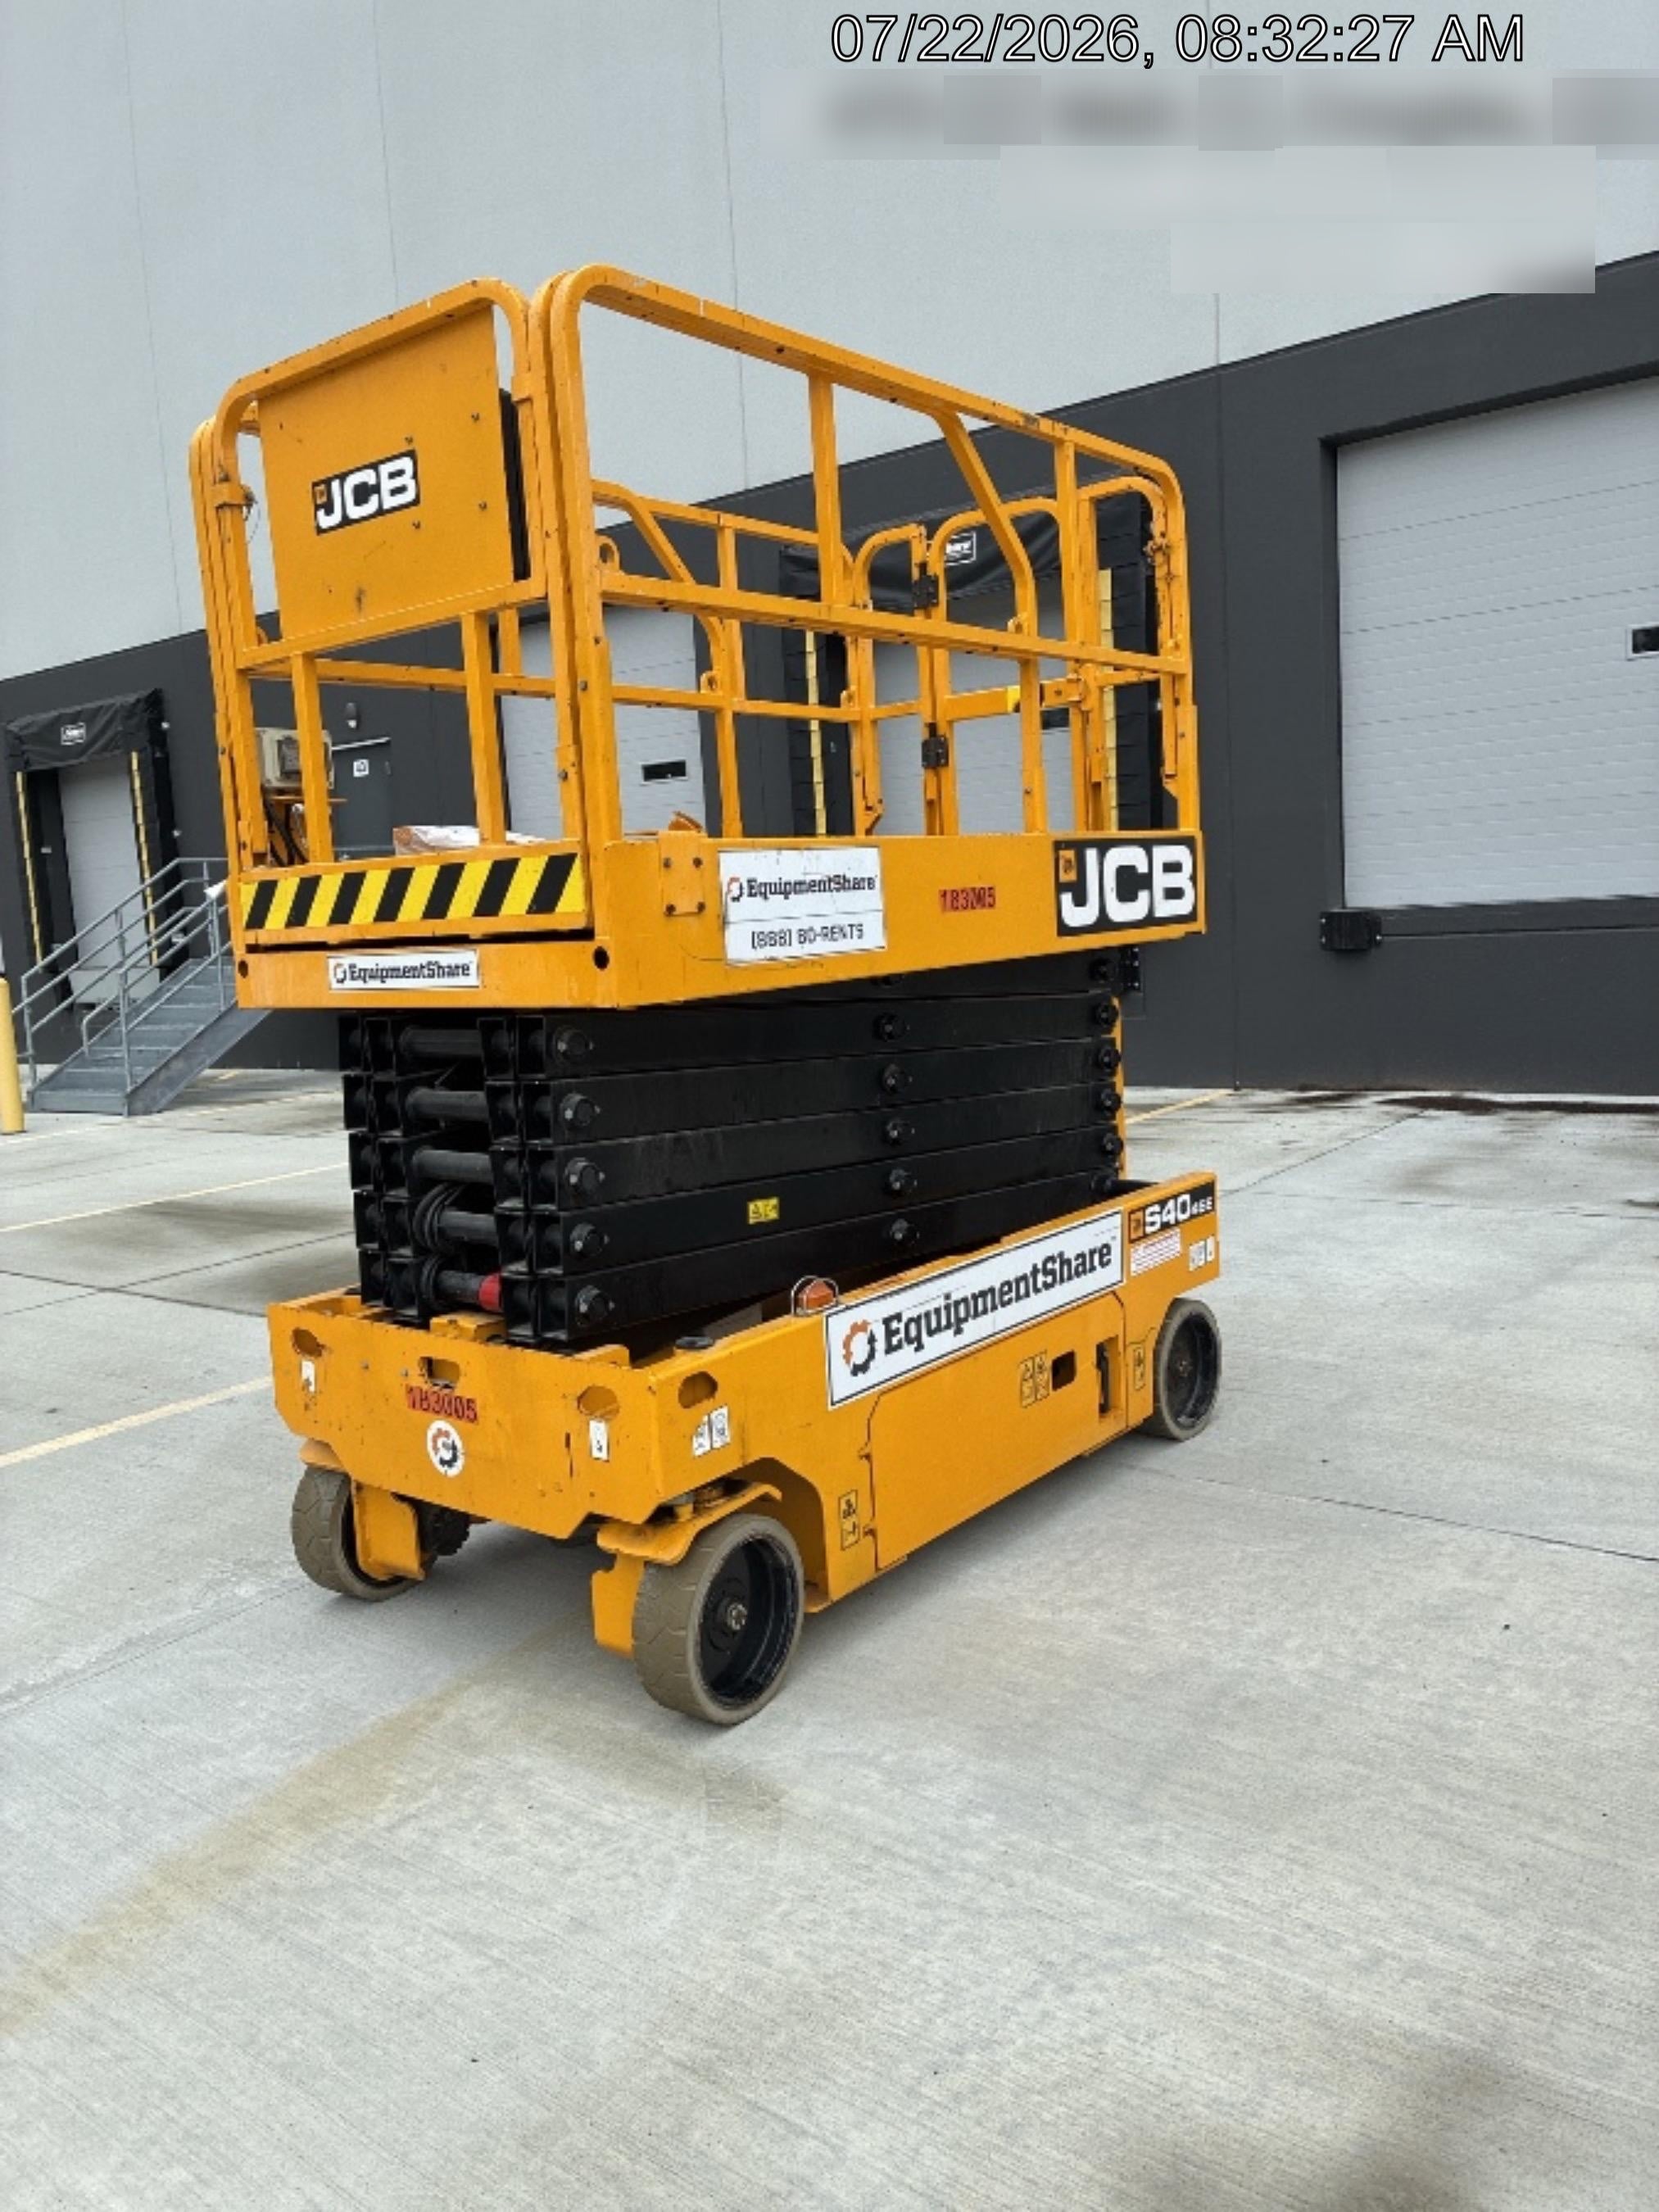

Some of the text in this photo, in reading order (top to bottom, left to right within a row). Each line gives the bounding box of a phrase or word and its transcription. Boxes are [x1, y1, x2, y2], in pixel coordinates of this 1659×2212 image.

[315, 456, 417, 530] JCB
[746, 873, 876, 900] EquipmentShare
[1060, 844, 1195, 927] JCB
[348, 959, 470, 984] EquipmentShare
[882, 1240, 1113, 1356] EquipmentShare
